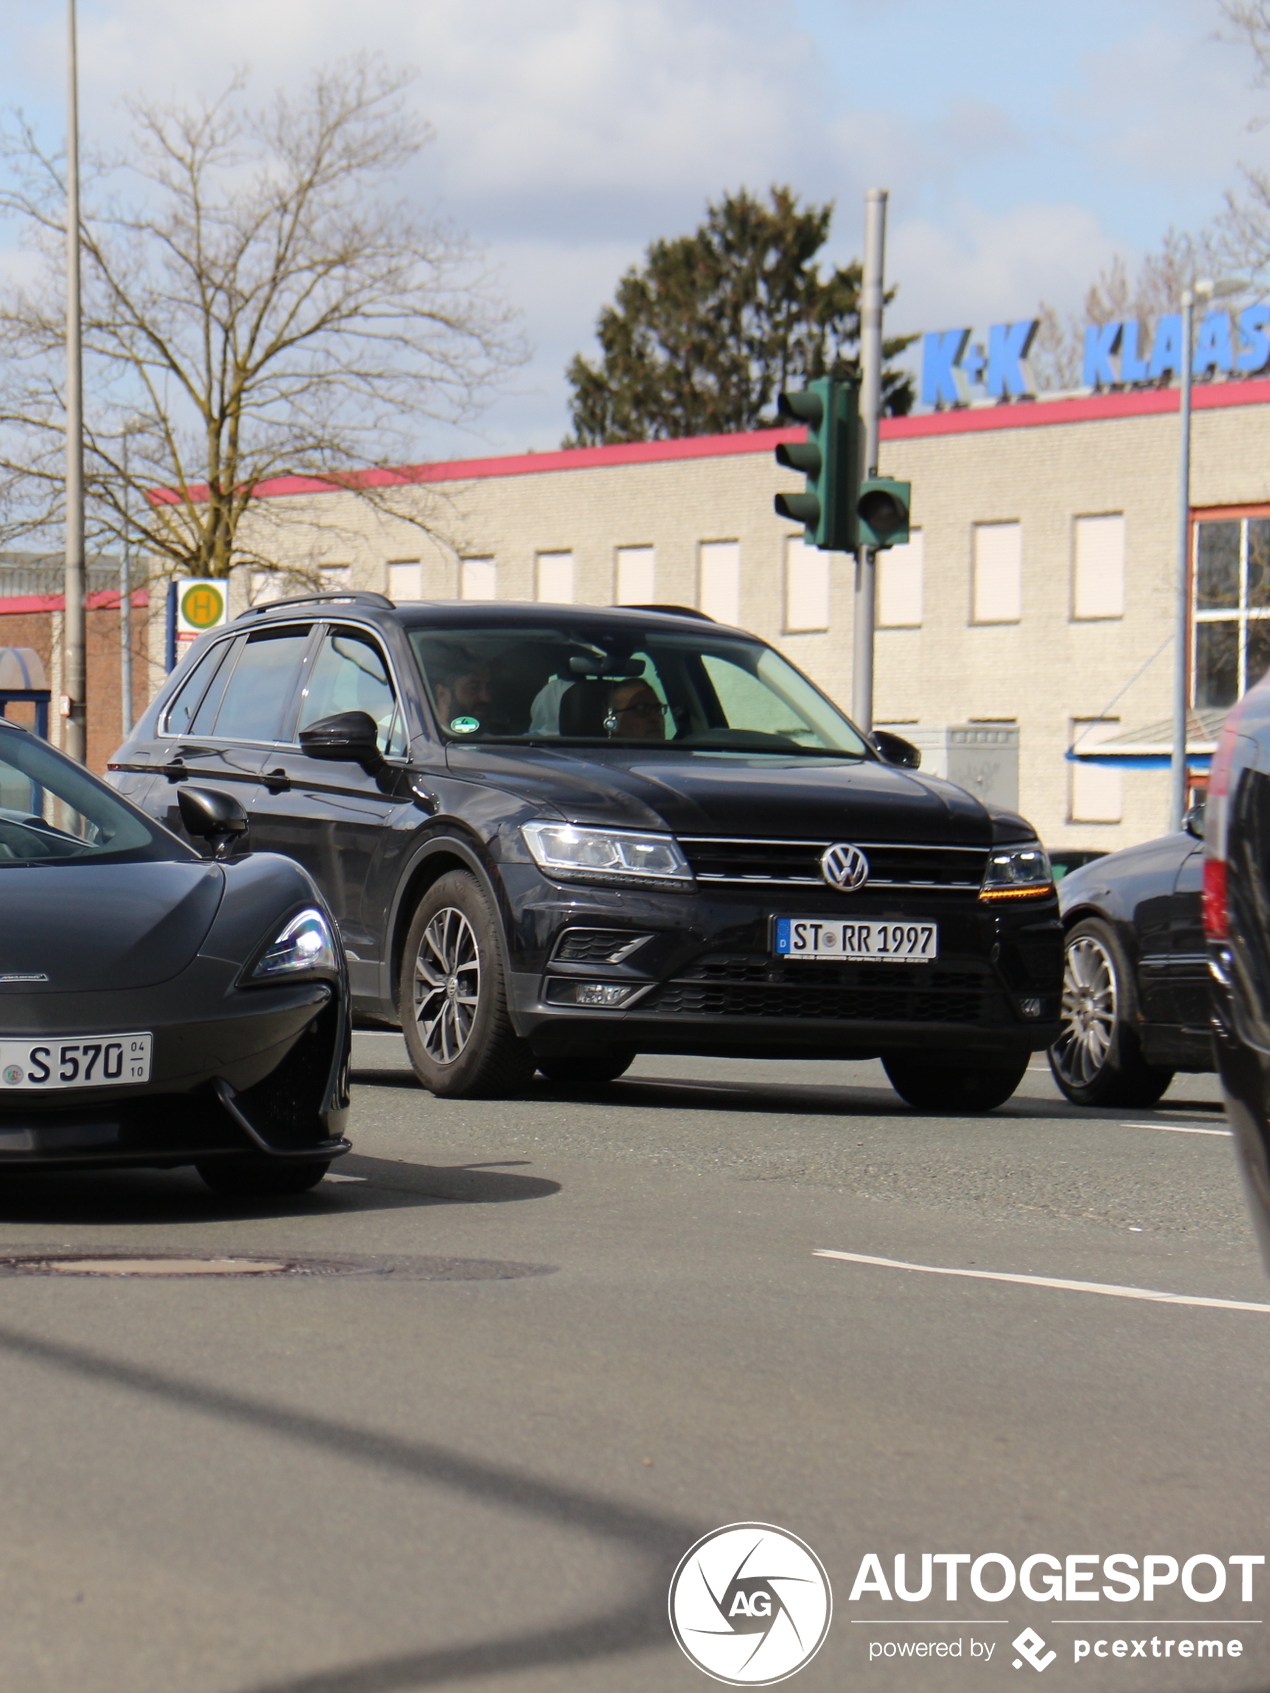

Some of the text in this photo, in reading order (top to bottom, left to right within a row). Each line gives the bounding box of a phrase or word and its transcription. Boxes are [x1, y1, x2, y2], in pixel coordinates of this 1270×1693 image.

[1083, 304, 1270, 387] KLAAS
[793, 923, 933, 954] ST RR 1997
[130, 1041, 144, 1052] 04
[27, 1046, 51, 1083] S
[59, 1042, 123, 1081] 570
[130, 1066, 144, 1077] 10
